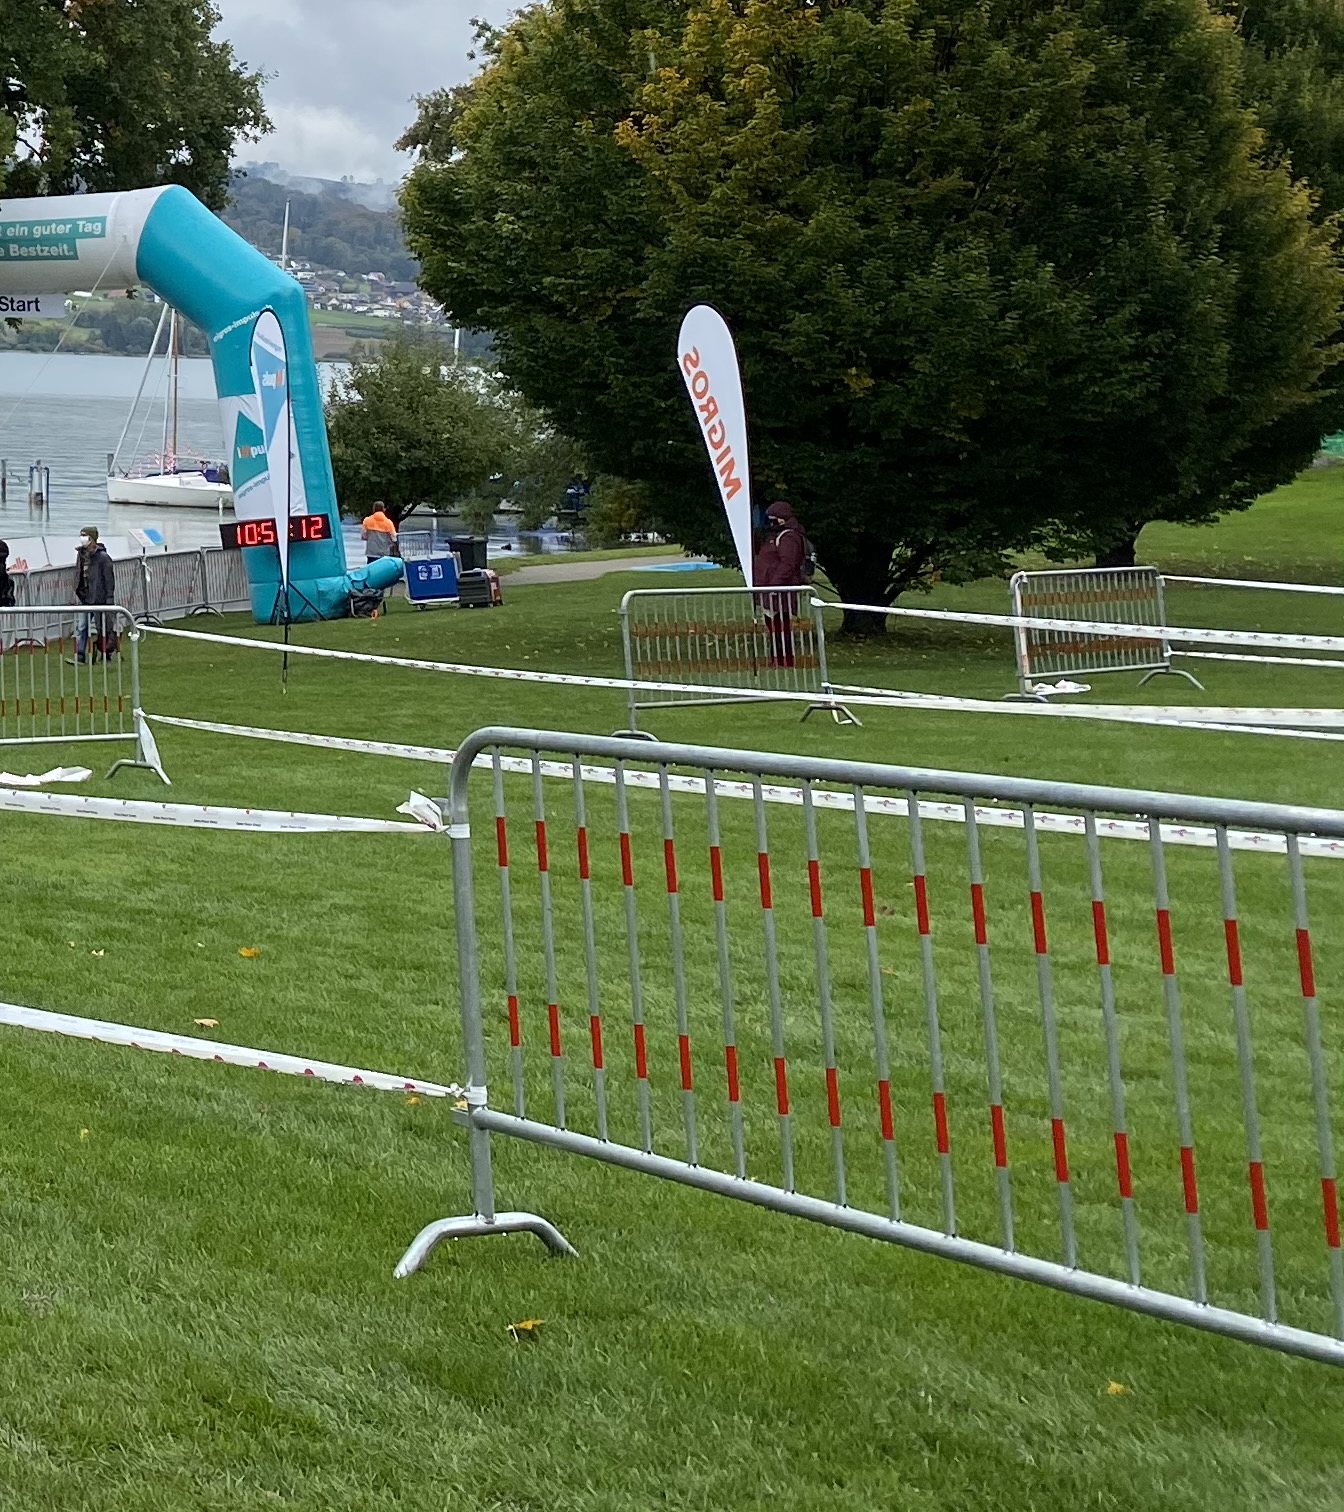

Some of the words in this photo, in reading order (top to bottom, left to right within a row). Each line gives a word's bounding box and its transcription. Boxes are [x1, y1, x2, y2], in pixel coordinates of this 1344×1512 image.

[7, 223, 29, 237] ein
[33, 223, 72, 239] guter
[76, 220, 102, 234] Tag
[9, 244, 74, 257] Bestzeit.
[237, 444, 266, 459] iMpu
